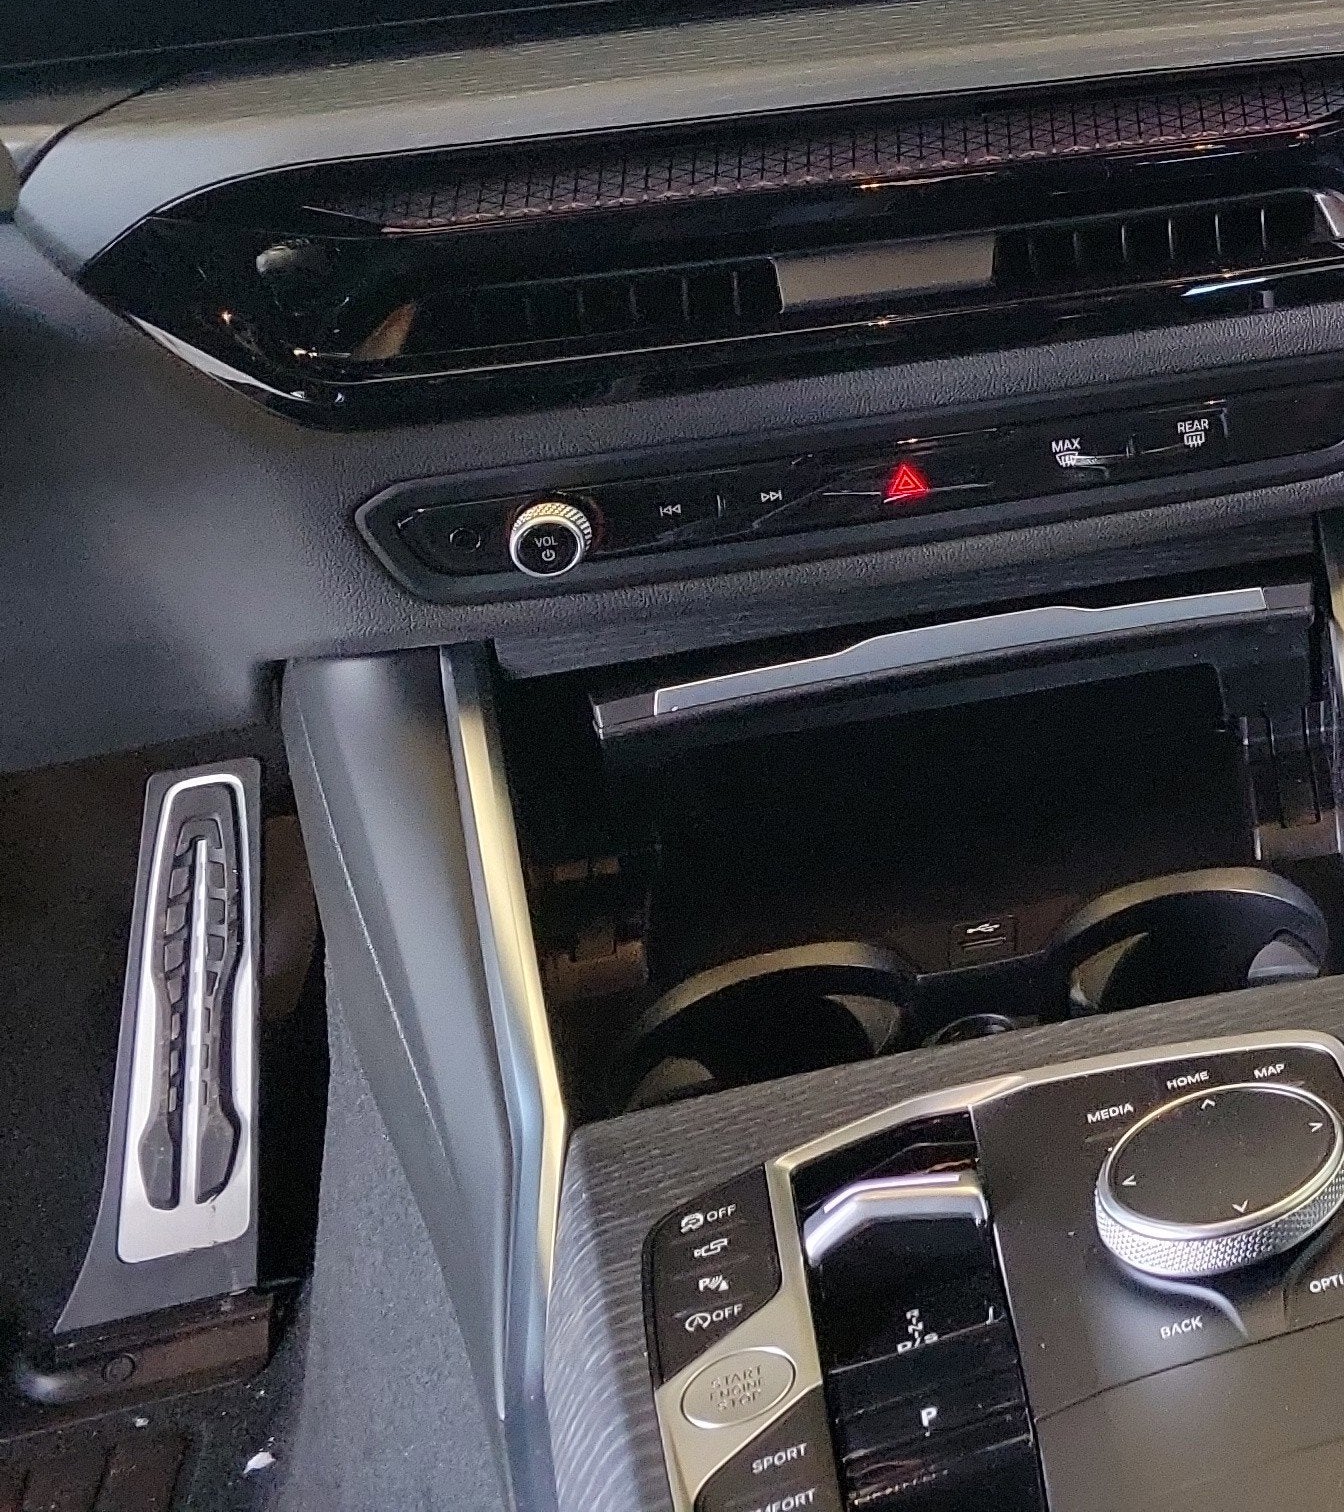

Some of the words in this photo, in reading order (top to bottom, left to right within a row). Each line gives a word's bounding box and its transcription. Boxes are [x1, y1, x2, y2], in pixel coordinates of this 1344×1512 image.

[1176, 418, 1210, 434] REAR
[1051, 437, 1081, 454] MAX
[533, 534, 560, 550] VOL
[1165, 1070, 1211, 1091] HOME
[1253, 1062, 1286, 1080] MAP
[1086, 1102, 1135, 1124] MEDIA
[706, 1202, 738, 1225] OFF
[712, 1301, 744, 1324] OFF
[1159, 1315, 1203, 1340] BACK
[709, 1364, 763, 1390] START
[709, 1377, 767, 1402] ENGINE
[921, 1405, 938, 1428] P
[752, 1441, 808, 1475] SPORT
[752, 1487, 817, 1512] MFORT
